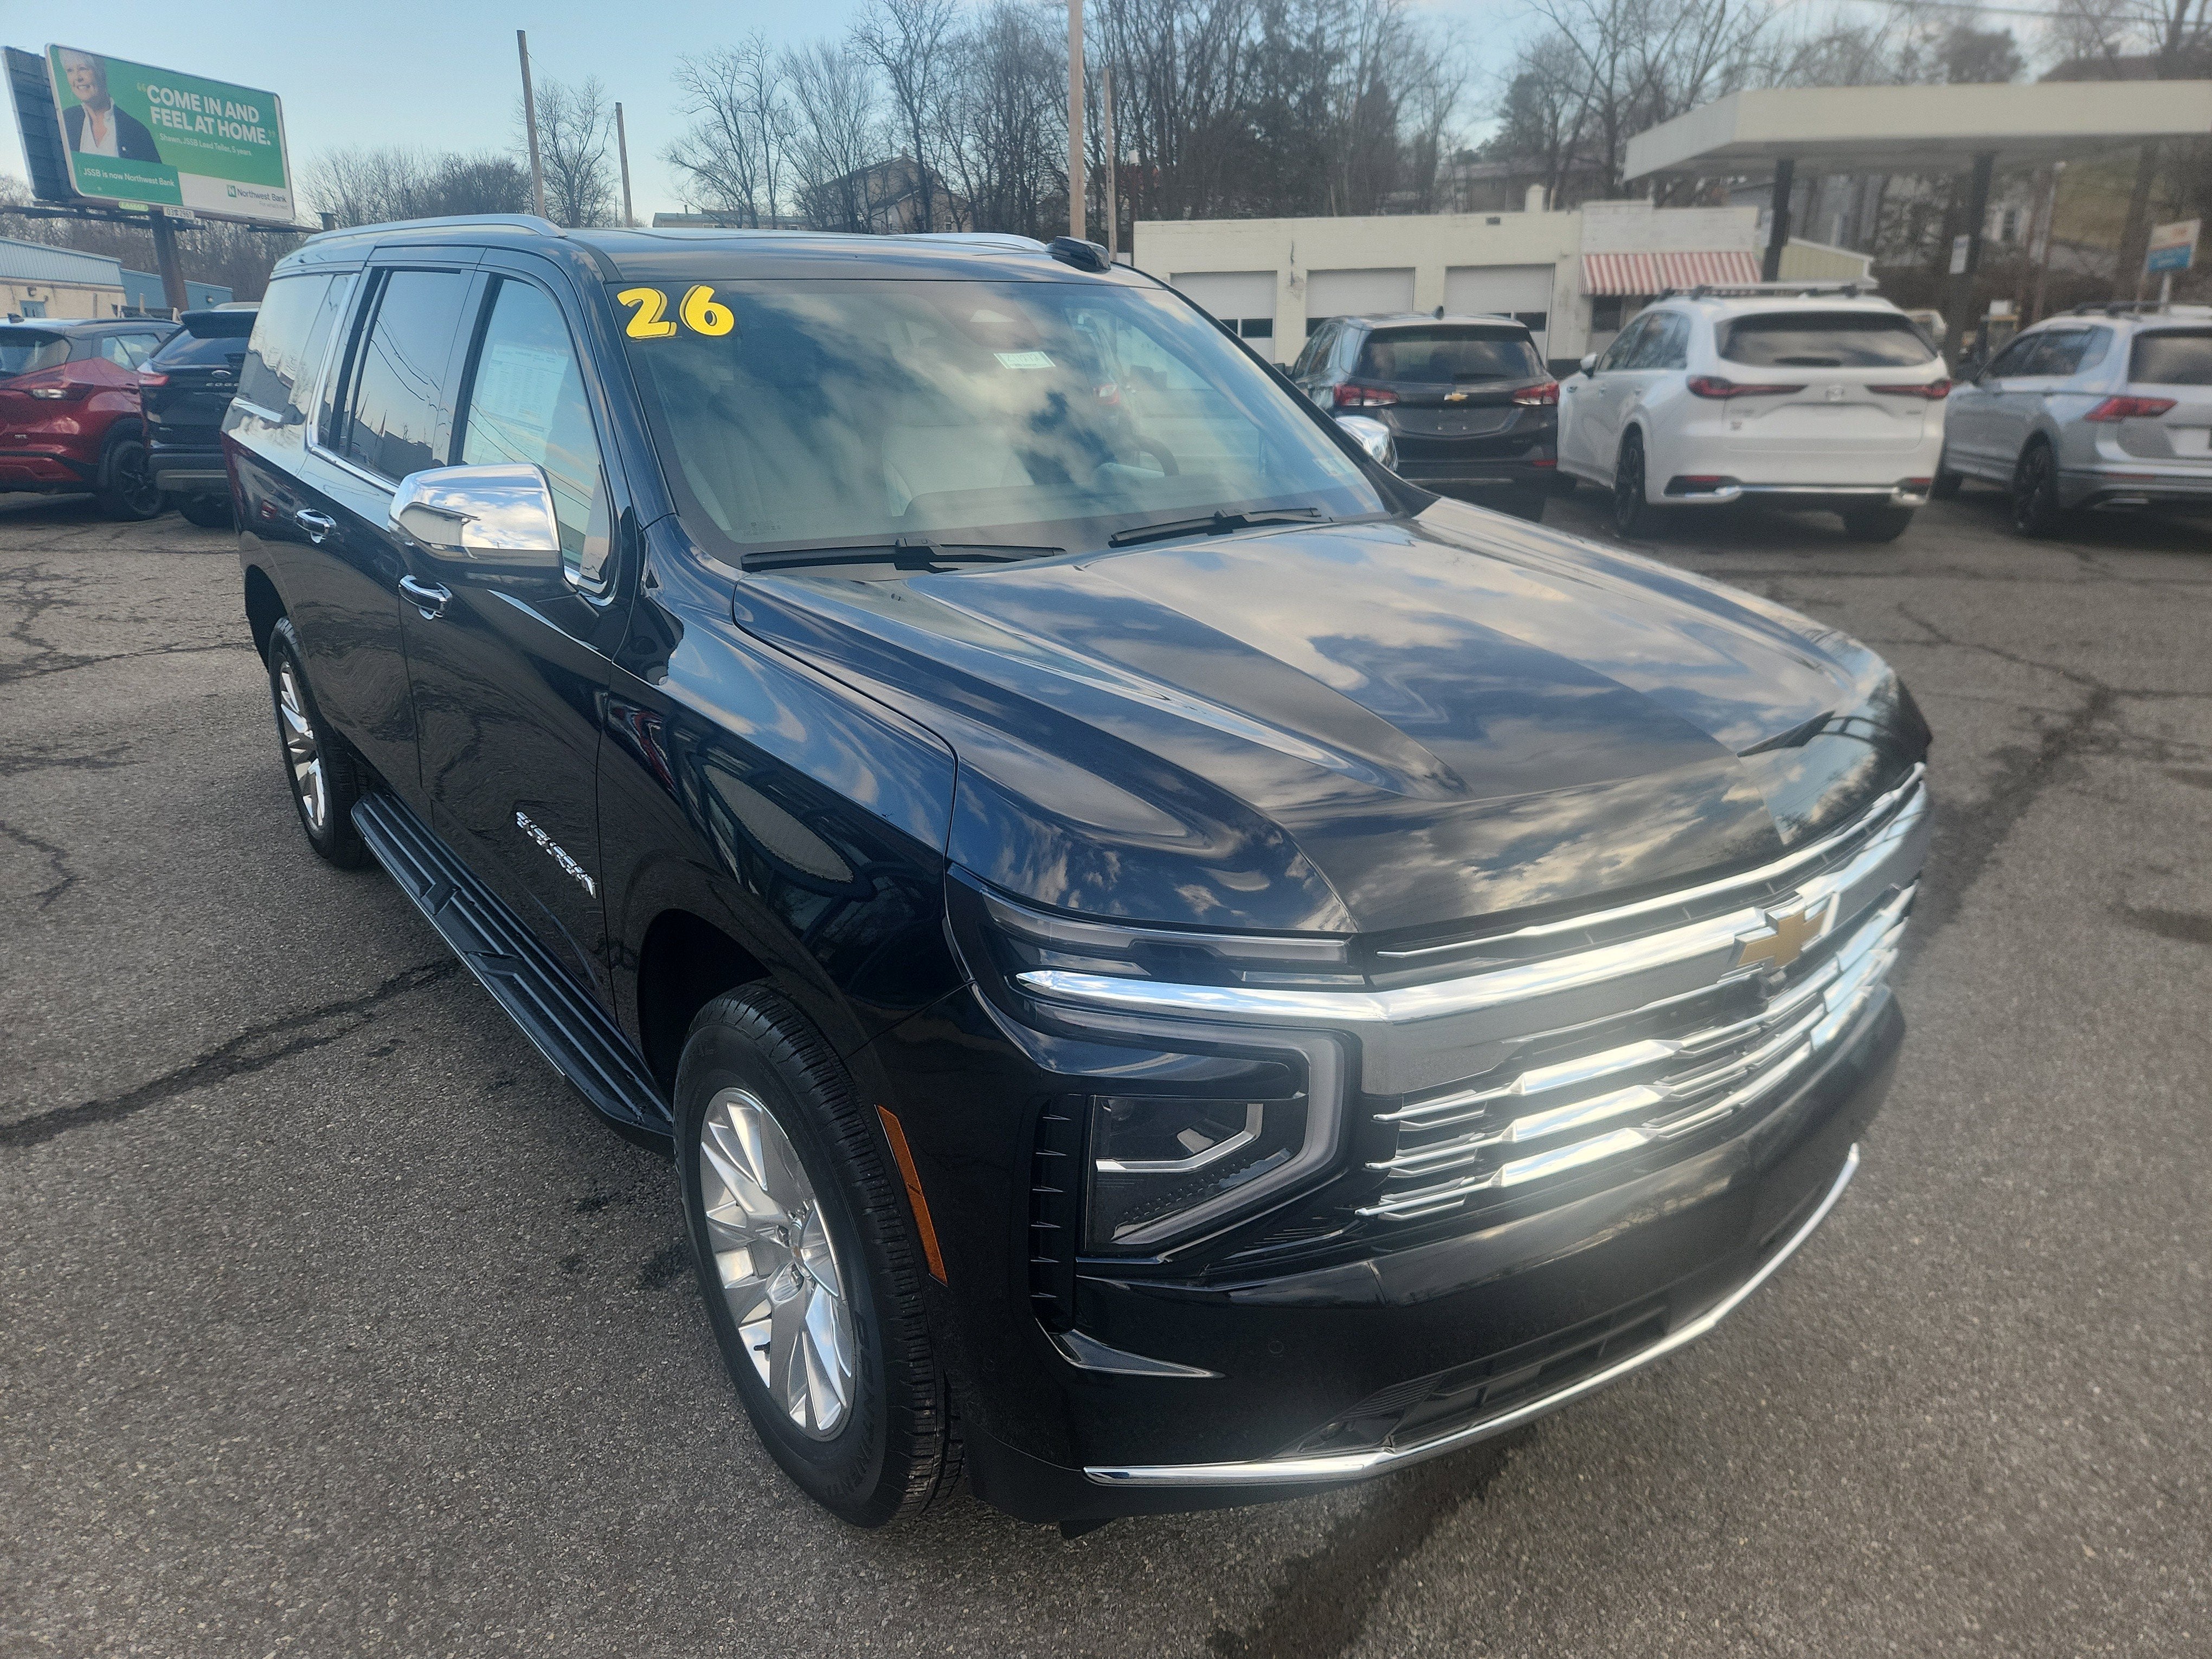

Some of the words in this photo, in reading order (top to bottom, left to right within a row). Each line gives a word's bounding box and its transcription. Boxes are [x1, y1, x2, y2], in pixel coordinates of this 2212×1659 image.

[150, 106, 193, 131] FEEL
[195, 115, 215, 134] AT
[204, 96, 222, 116] IN
[225, 101, 260, 124] AND
[183, 137, 198, 147] JSSB
[198, 140, 214, 150] Lead
[231, 145, 236, 153] 5
[83, 168, 101, 177] JSSB
[102, 170, 108, 178] is
[109, 172, 123, 180] now
[124, 172, 158, 185] Northwest
[159, 177, 176, 187] Bank
[237, 188, 271, 201] Northwest
[271, 193, 287, 203] Bank
[616, 284, 735, 339] 26
